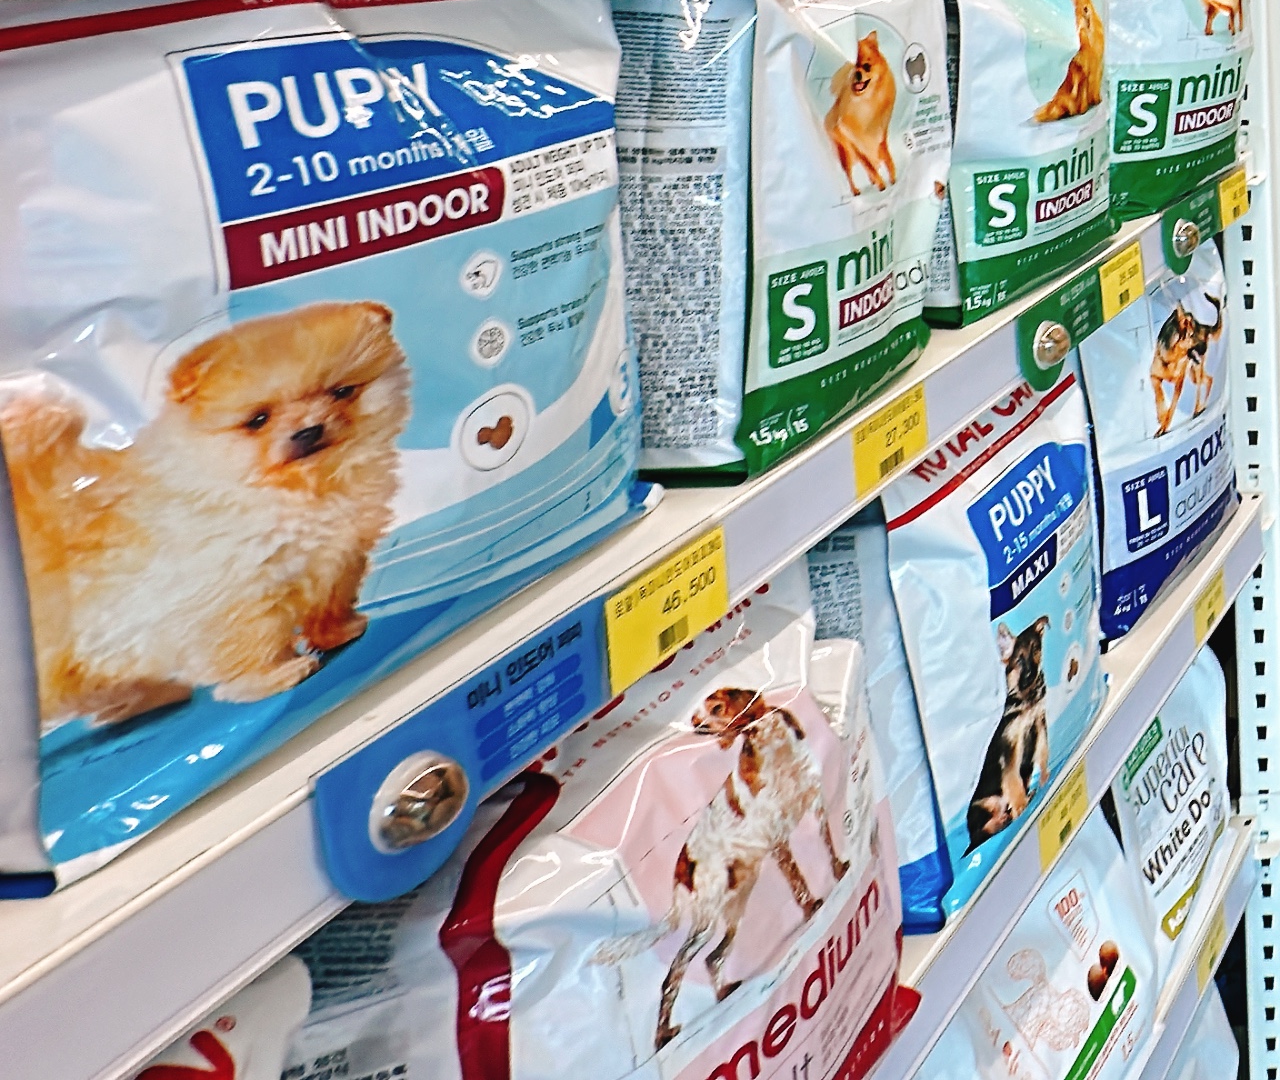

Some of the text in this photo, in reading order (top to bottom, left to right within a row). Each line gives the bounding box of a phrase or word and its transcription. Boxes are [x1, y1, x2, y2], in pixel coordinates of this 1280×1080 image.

[1120, 83, 1145, 93] SIZE
[1177, 57, 1243, 106] mini
[1126, 93, 1159, 137] S
[1177, 101, 1235, 133] INDOOR
[246, 138, 444, 198] 2-10 months
[976, 175, 1001, 185] SIZE
[1037, 138, 1095, 194] mini
[260, 183, 490, 268] MINI INDOOR
[987, 182, 1017, 229] S
[1038, 183, 1093, 221] INDOOR
[771, 272, 797, 289] SIZE
[836, 219, 895, 292] mini
[782, 282, 817, 342] S
[988, 455, 1057, 542] PUPPY
[1124, 479, 1146, 495] SIZE
[1137, 489, 1161, 532] L
[1174, 478, 1214, 520] adult
[1003, 533, 1029, 565] 2-15
[661, 565, 717, 616] 46,500
[1011, 549, 1050, 600] MAXI
[467, 678, 502, 710] 미니
[505, 637, 555, 686] 인도어
[1158, 730, 1207, 815] care
[1142, 820, 1191, 887] White
[702, 878, 880, 1080] medium
